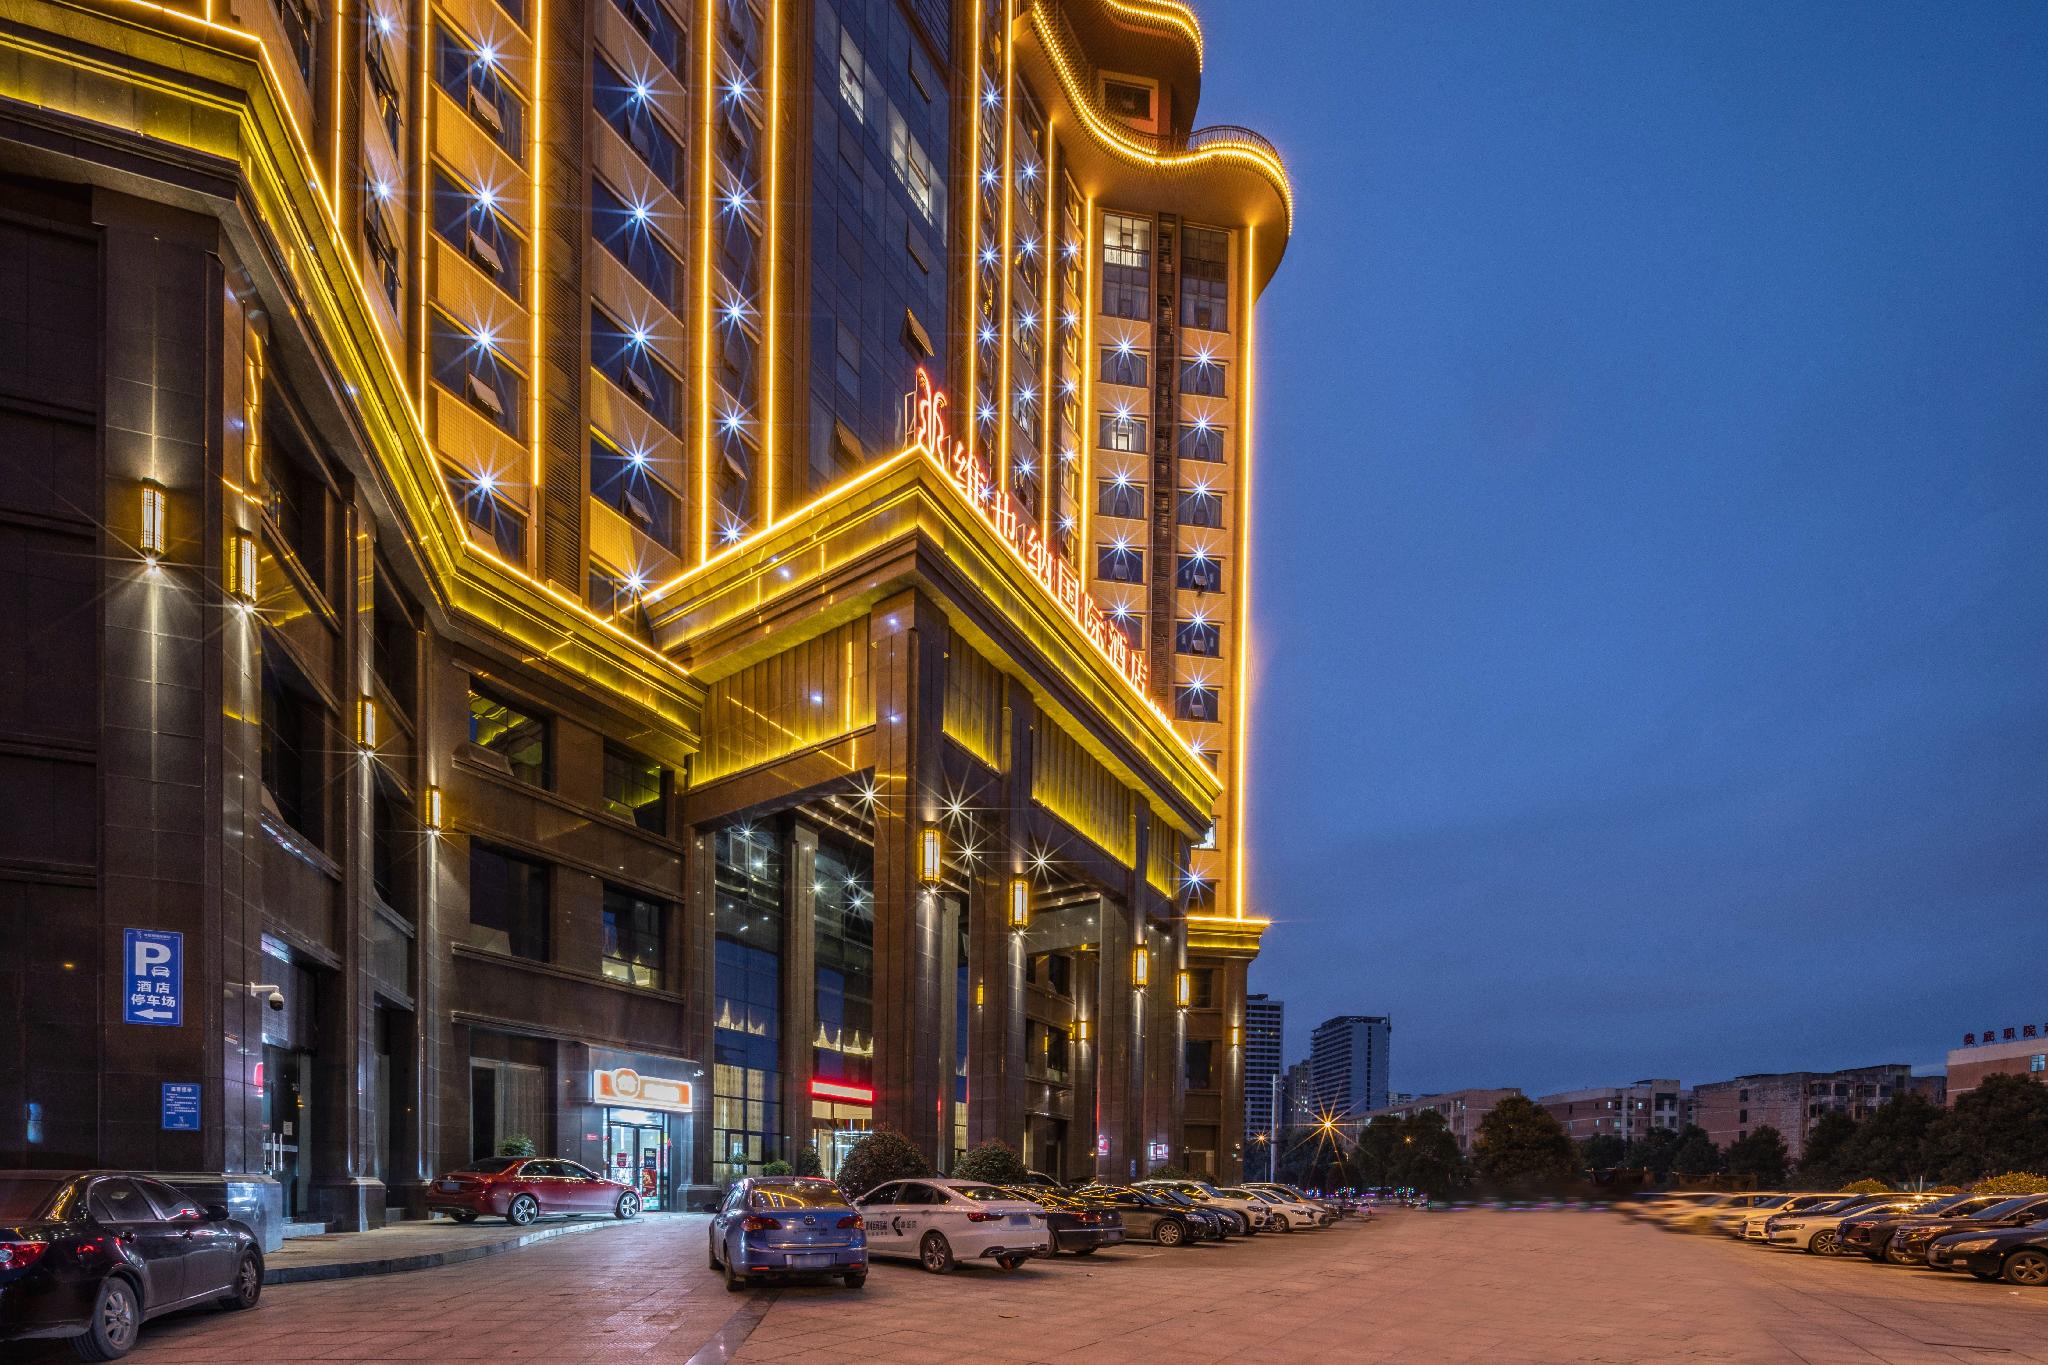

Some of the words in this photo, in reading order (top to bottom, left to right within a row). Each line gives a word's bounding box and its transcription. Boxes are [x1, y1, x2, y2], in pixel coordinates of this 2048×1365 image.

[954, 441, 1148, 696] 维也纳国际酒店
[135, 941, 171, 976] P
[136, 980, 170, 994] 酒店
[131, 993, 176, 1008] 停车场
